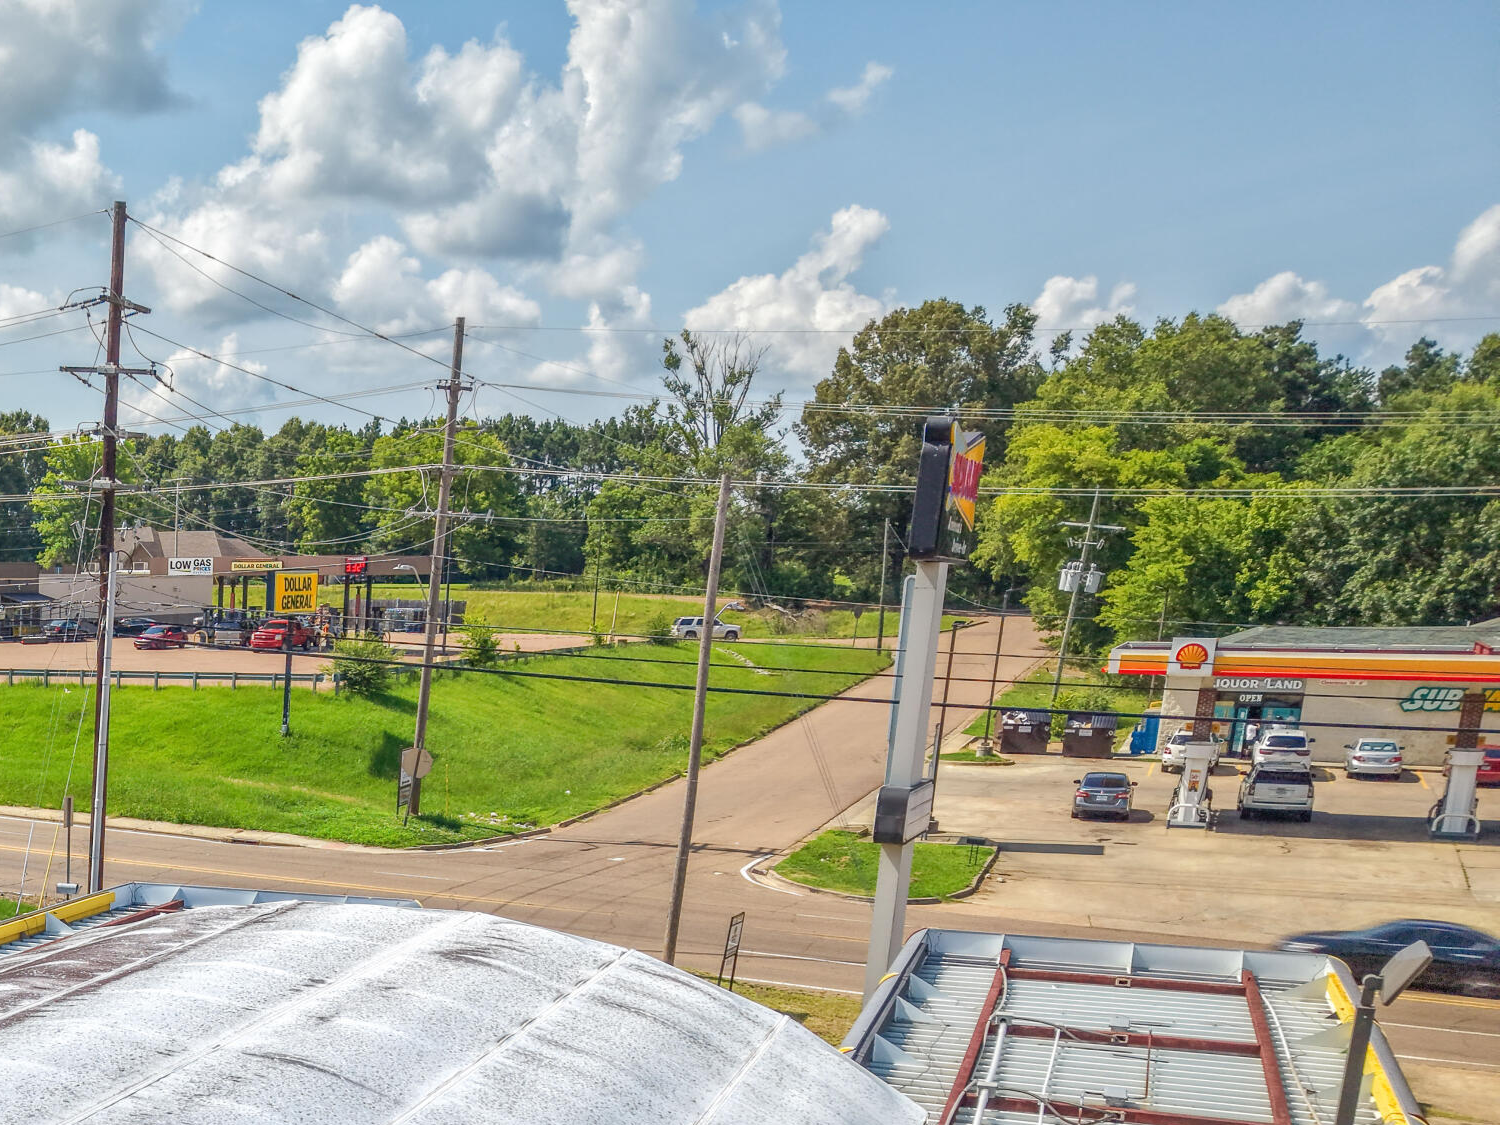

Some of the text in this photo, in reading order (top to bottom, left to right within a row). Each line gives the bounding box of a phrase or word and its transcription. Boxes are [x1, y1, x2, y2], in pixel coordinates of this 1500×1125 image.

[170, 561, 191, 570] LOW
[193, 559, 211, 567] GAS
[284, 577, 312, 592] DOLLAR
[282, 594, 312, 610] GENERAL
[1213, 678, 1303, 689] IQUOR LAND
[1239, 694, 1263, 702] OPEN
[1400, 687, 1500, 711] SUBA
